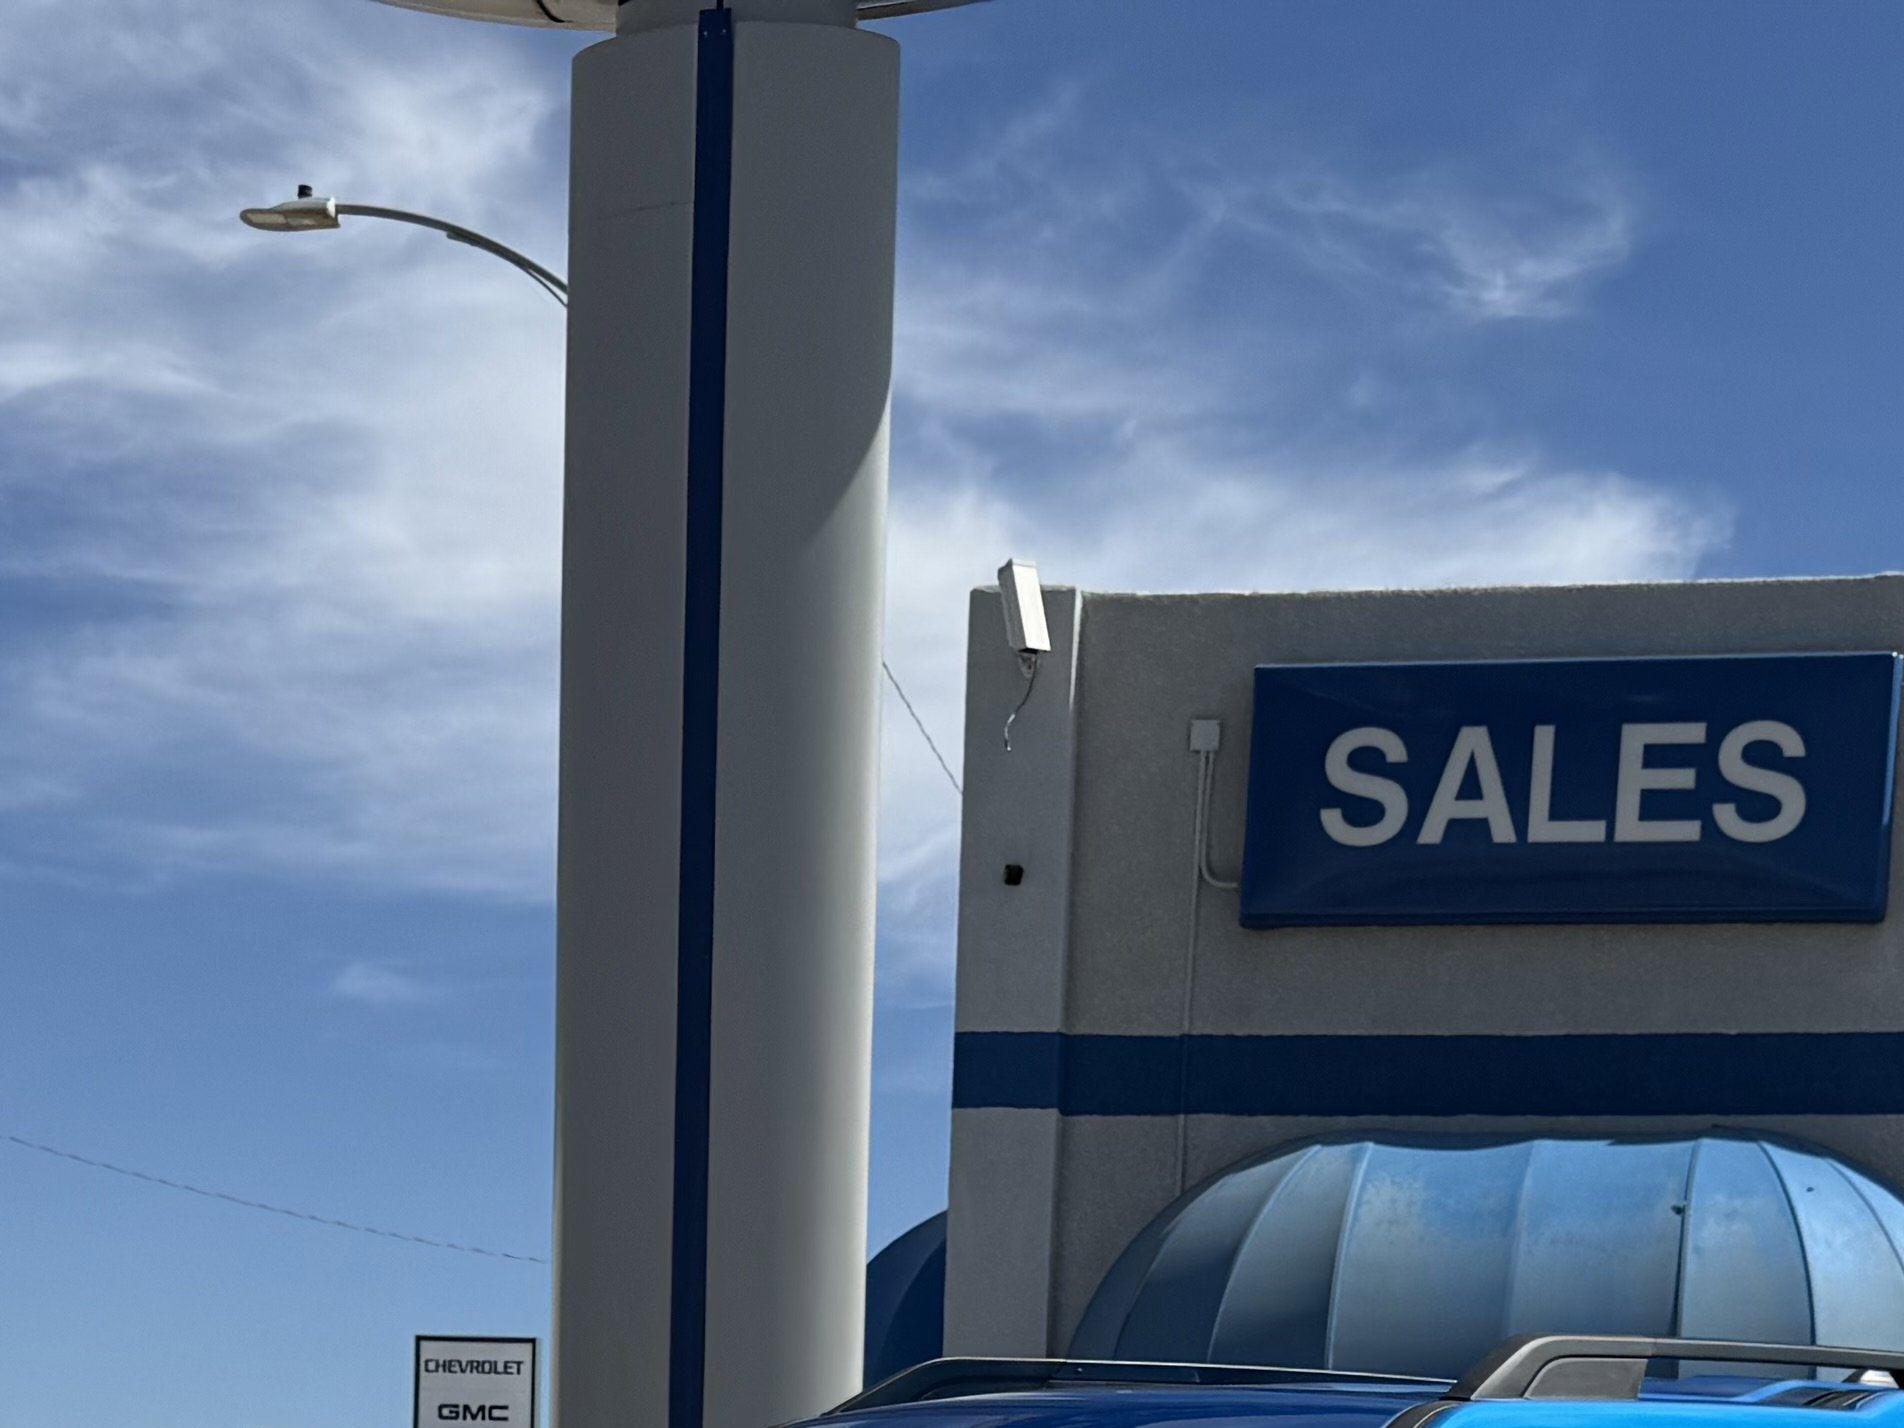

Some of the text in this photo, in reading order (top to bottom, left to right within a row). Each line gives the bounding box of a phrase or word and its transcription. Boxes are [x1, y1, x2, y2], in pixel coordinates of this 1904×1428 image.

[1319, 720, 1807, 848] SALES
[424, 1359, 524, 1375] CHEVROLET
[437, 1403, 509, 1421] GMC
